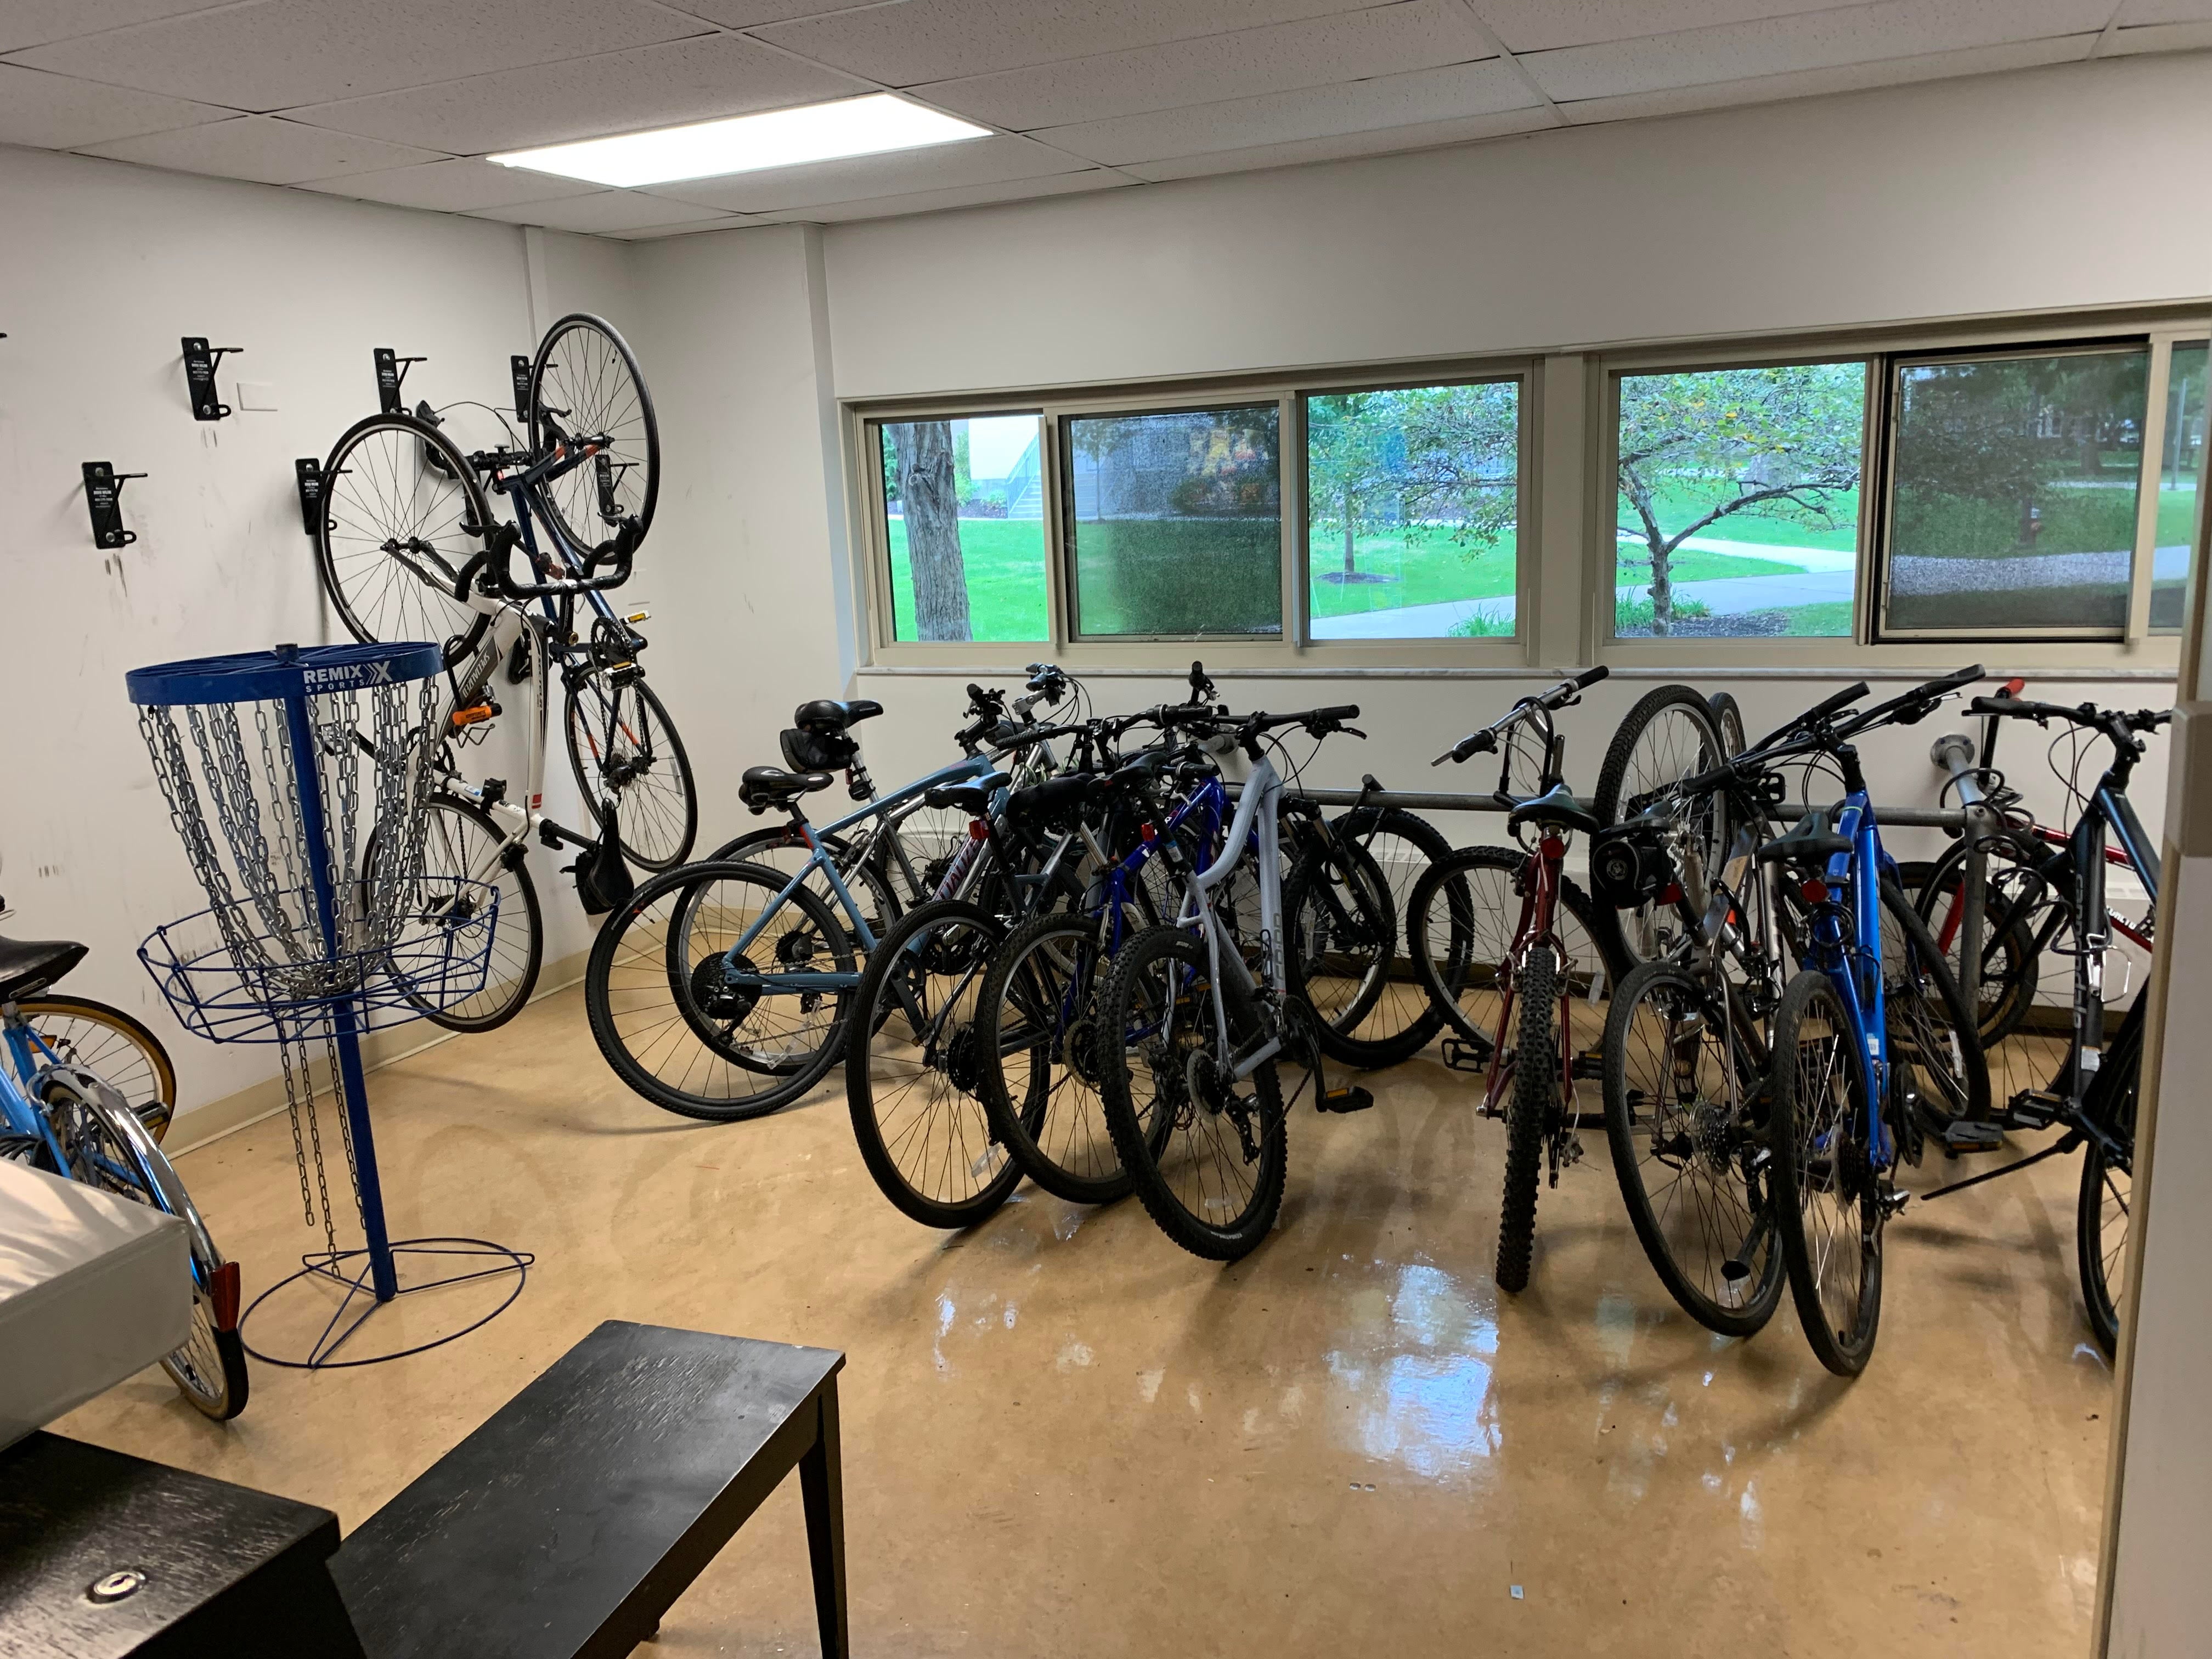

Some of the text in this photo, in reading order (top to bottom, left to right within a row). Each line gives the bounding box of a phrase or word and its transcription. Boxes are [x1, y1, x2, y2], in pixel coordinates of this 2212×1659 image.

[303, 664, 363, 684] REMIX
[462, 650, 490, 698] SPECIALIZED
[306, 679, 365, 693] SPORTS
